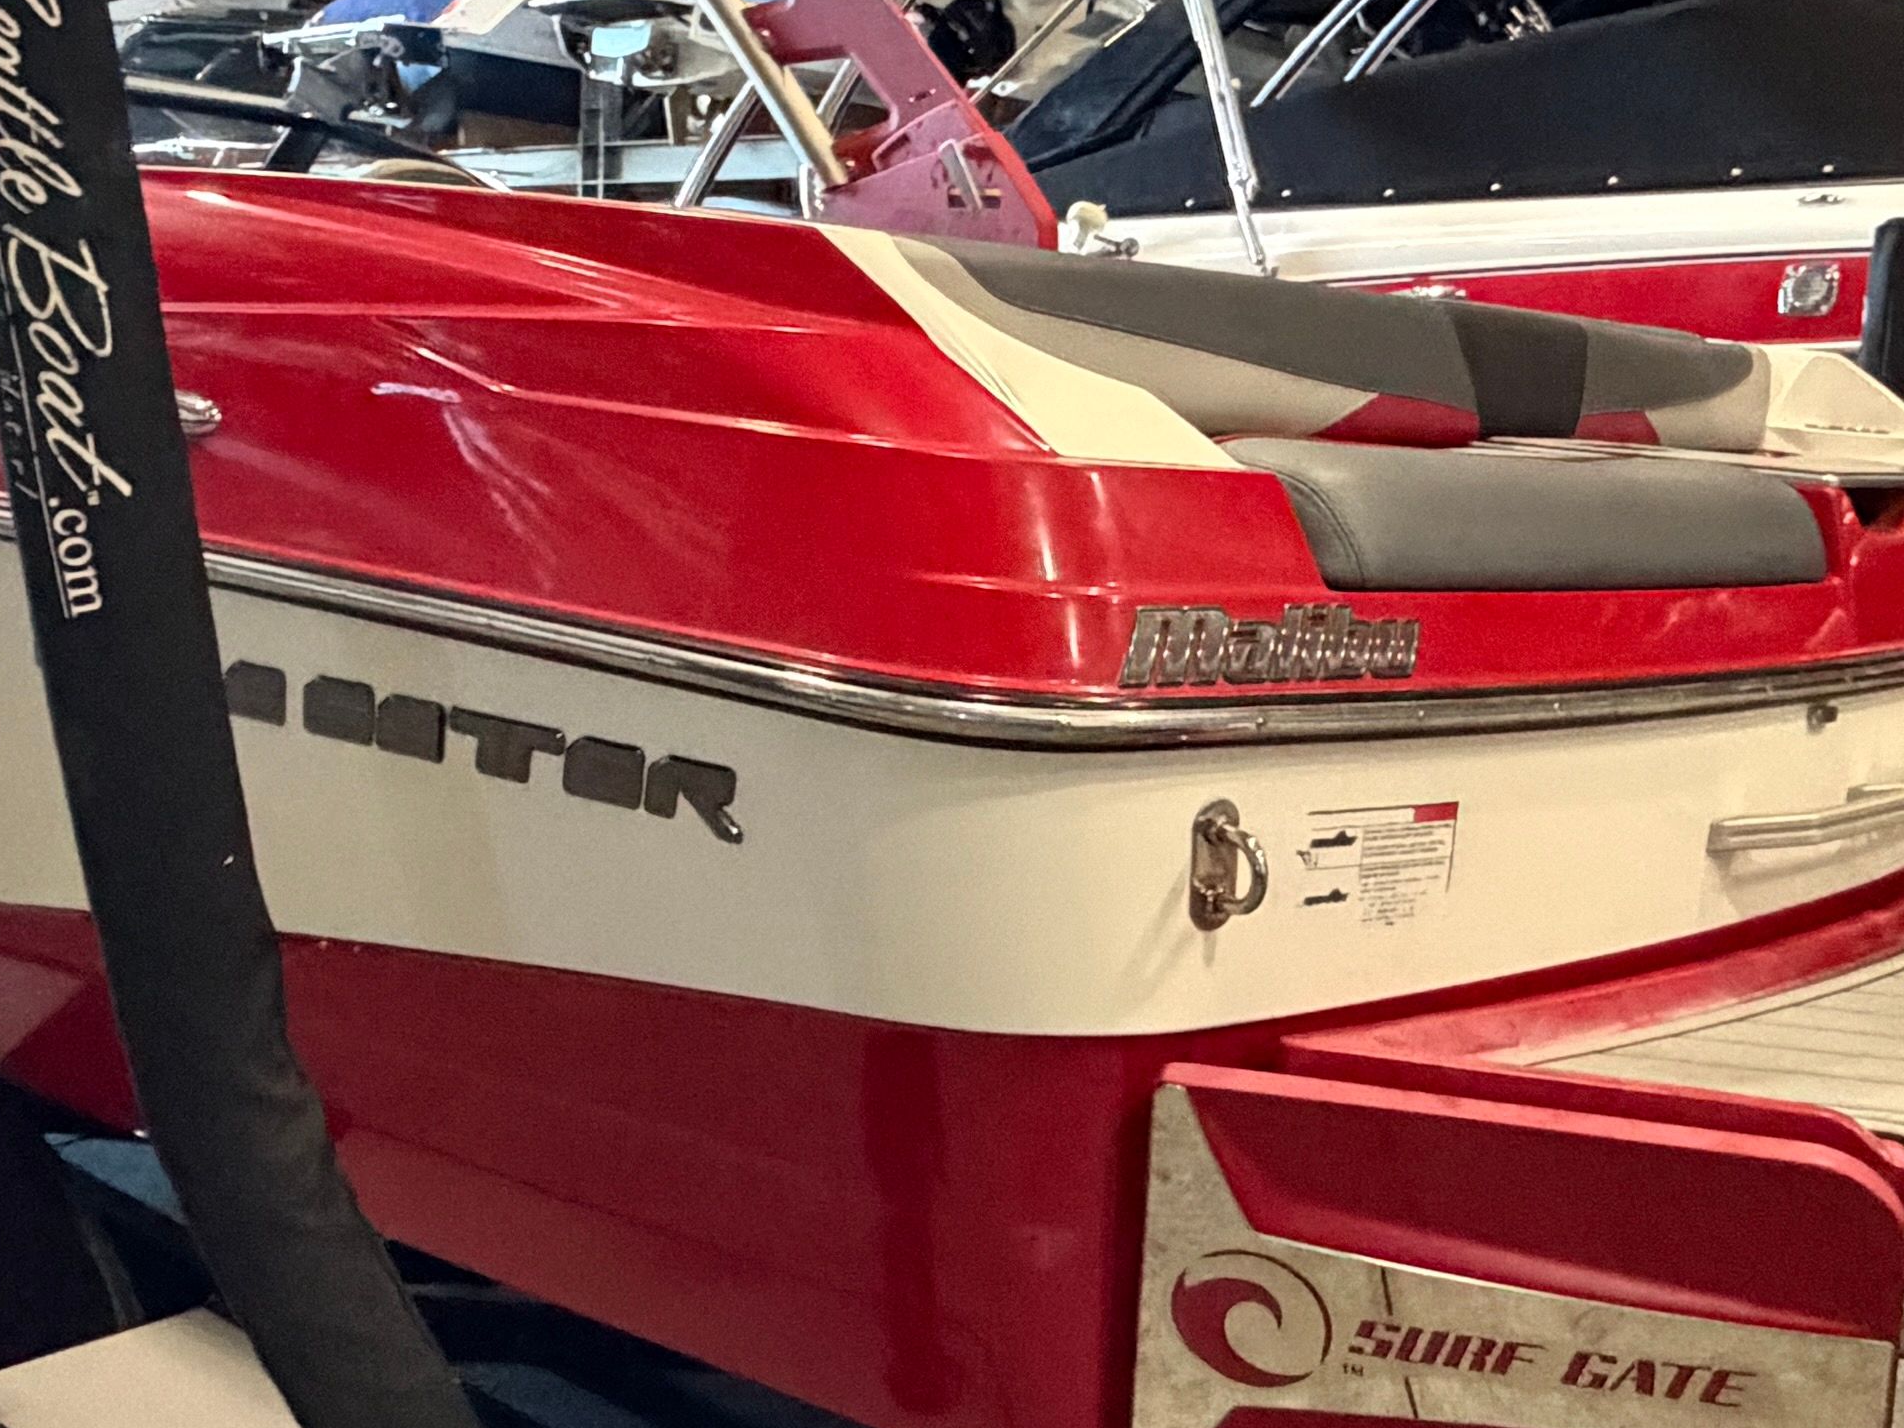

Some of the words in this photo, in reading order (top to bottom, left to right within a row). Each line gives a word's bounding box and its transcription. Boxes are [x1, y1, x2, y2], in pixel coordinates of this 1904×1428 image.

[1118, 603, 1420, 688] Malibu
[1347, 1319, 1547, 1376] SURF
[1561, 1350, 1758, 1409] GATE
